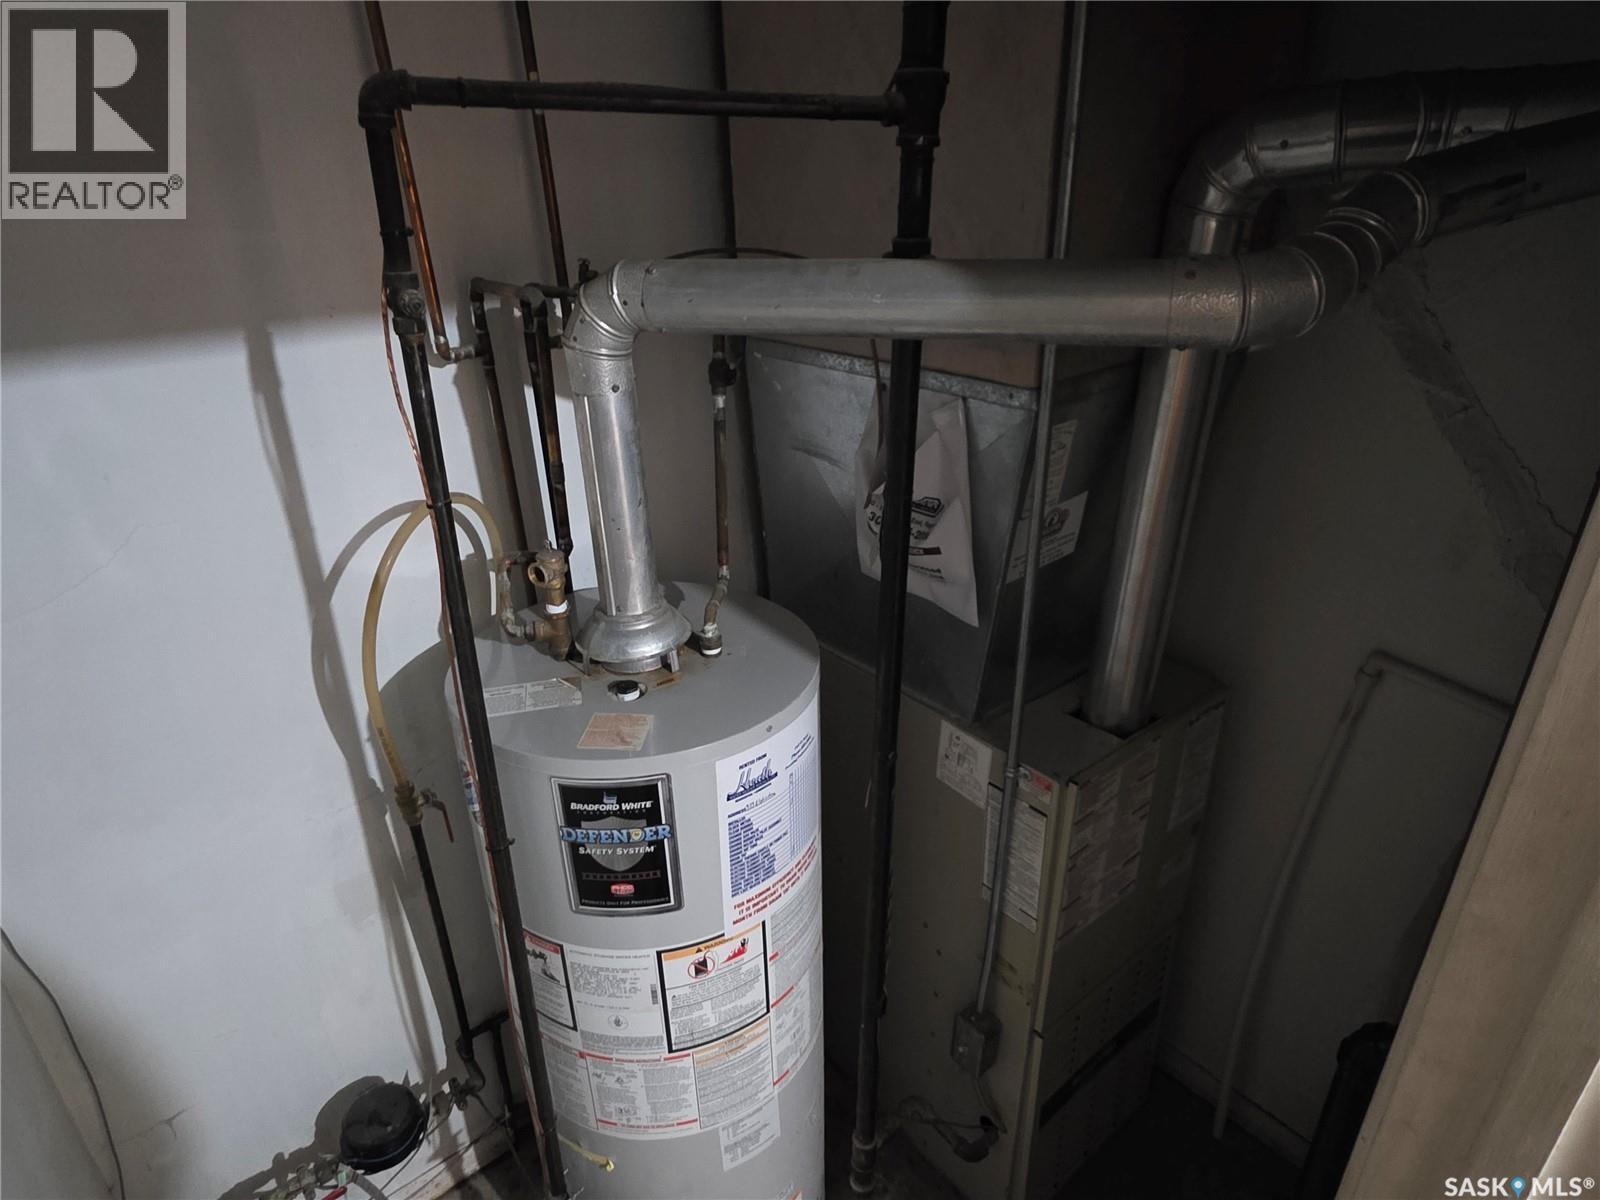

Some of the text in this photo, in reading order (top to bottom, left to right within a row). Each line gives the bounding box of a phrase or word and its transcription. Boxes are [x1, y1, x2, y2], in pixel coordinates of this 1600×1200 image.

[570, 801, 653, 811] BRADFORD WHITE
[560, 825, 671, 844] DEFENDER
[579, 846, 613, 855] SAFETY
